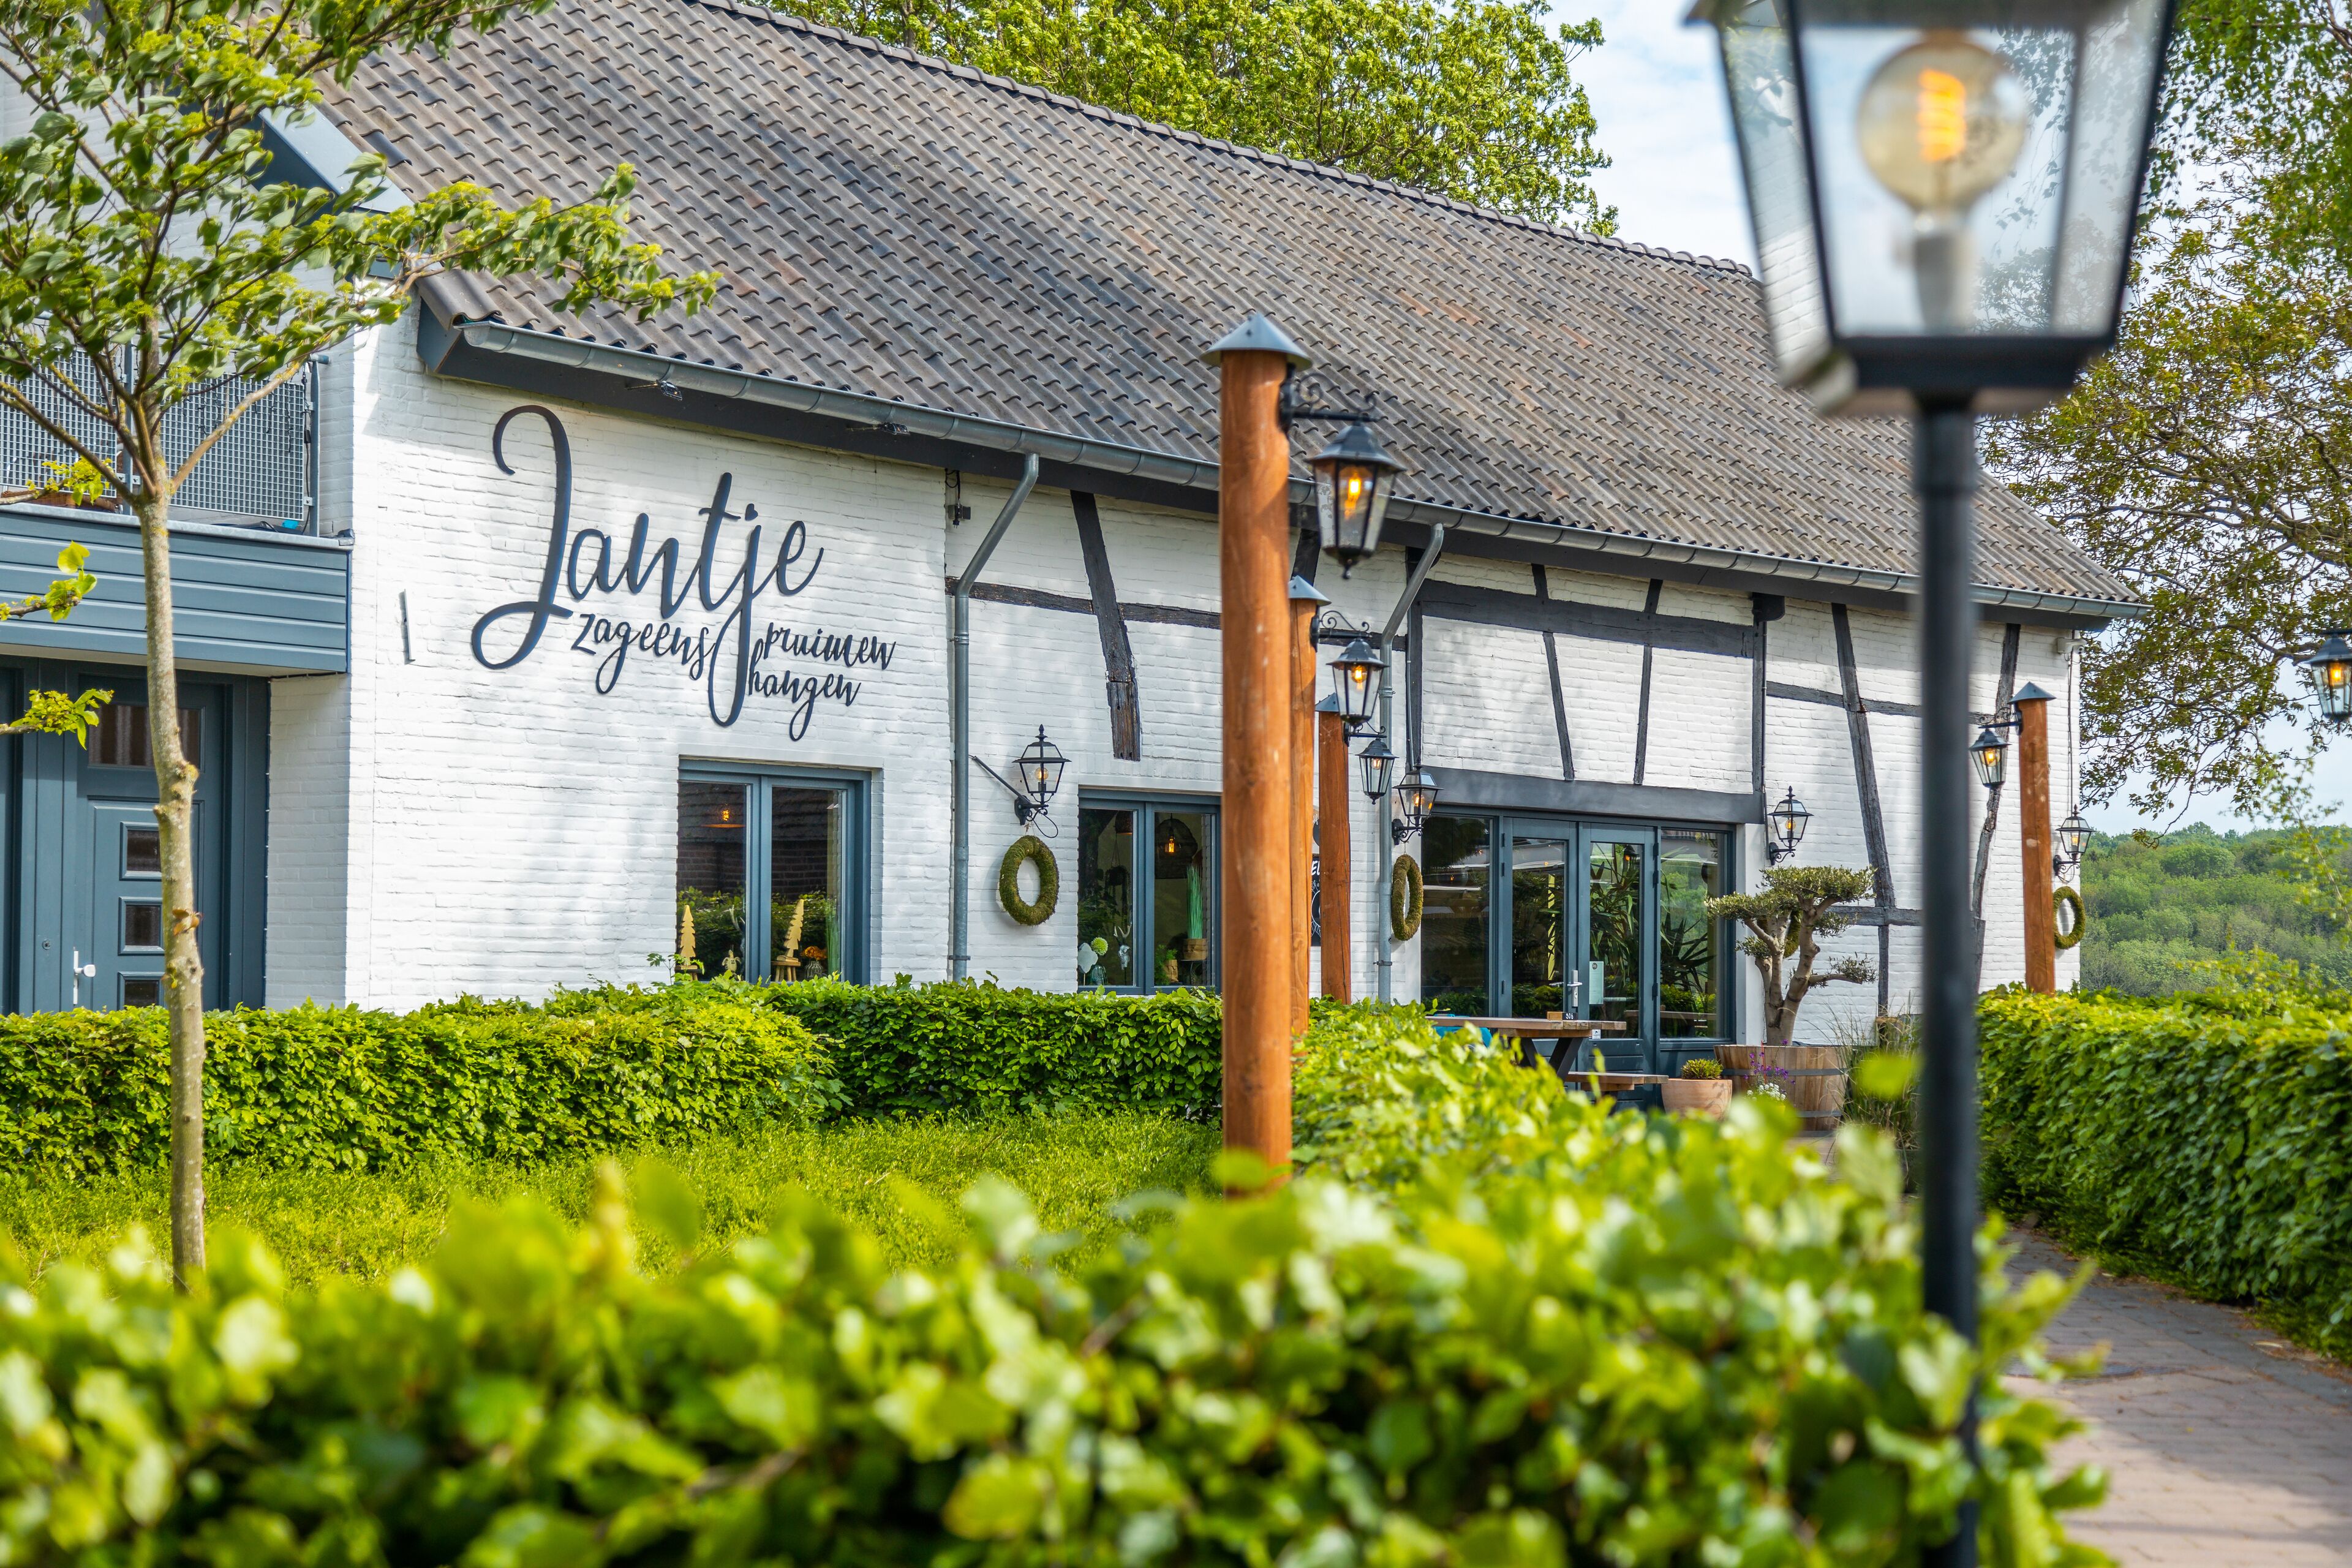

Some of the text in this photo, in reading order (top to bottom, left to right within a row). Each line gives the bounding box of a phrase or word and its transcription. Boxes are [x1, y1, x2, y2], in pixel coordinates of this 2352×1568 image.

[472, 405, 824, 726] Jantje
[748, 638, 861, 742] hangen
[764, 622, 896, 670] pruimen
